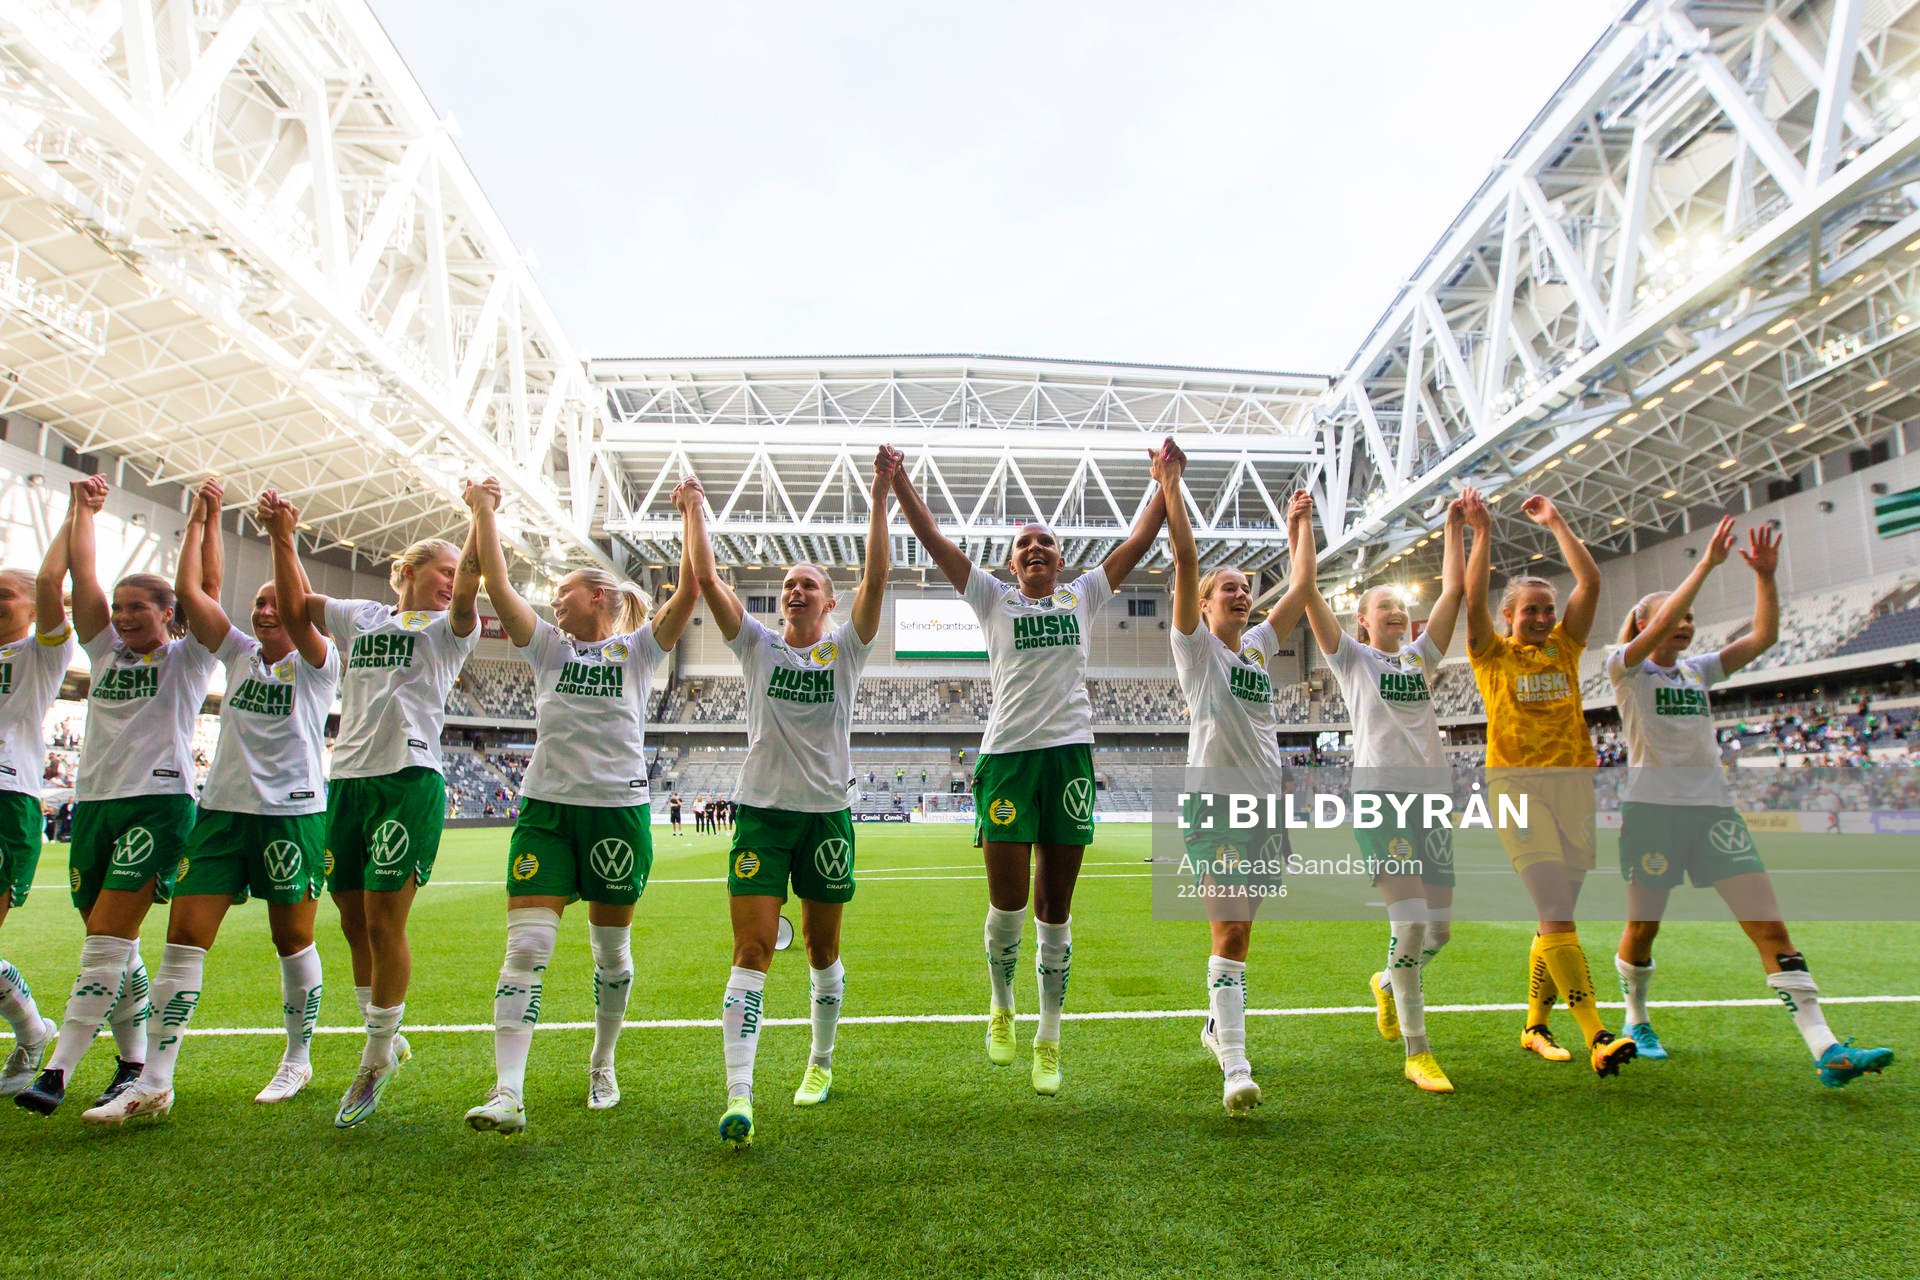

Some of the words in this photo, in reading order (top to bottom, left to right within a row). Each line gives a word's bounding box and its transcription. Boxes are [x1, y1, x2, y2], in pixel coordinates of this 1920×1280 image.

[899, 621, 931, 631] Sefina
[1013, 614, 1080, 638] HUSKI
[351, 633, 415, 657] HUSKI
[1014, 635, 1081, 650] CHOCOLATE
[349, 656, 412, 668] CHOCOLATE
[559, 662, 623, 686] HUSKI
[769, 666, 835, 692] HUSKI
[1380, 673, 1427, 692] HUSKI
[1517, 672, 1568, 692] HUSKI
[555, 683, 623, 697] CHOCOLATE
[767, 687, 834, 703] CHOCOLATE
[1380, 691, 1430, 701] CHOCOLATE
[1517, 691, 1572, 702] CHOCOLATE
[113, 869, 134, 877] CRAFT
